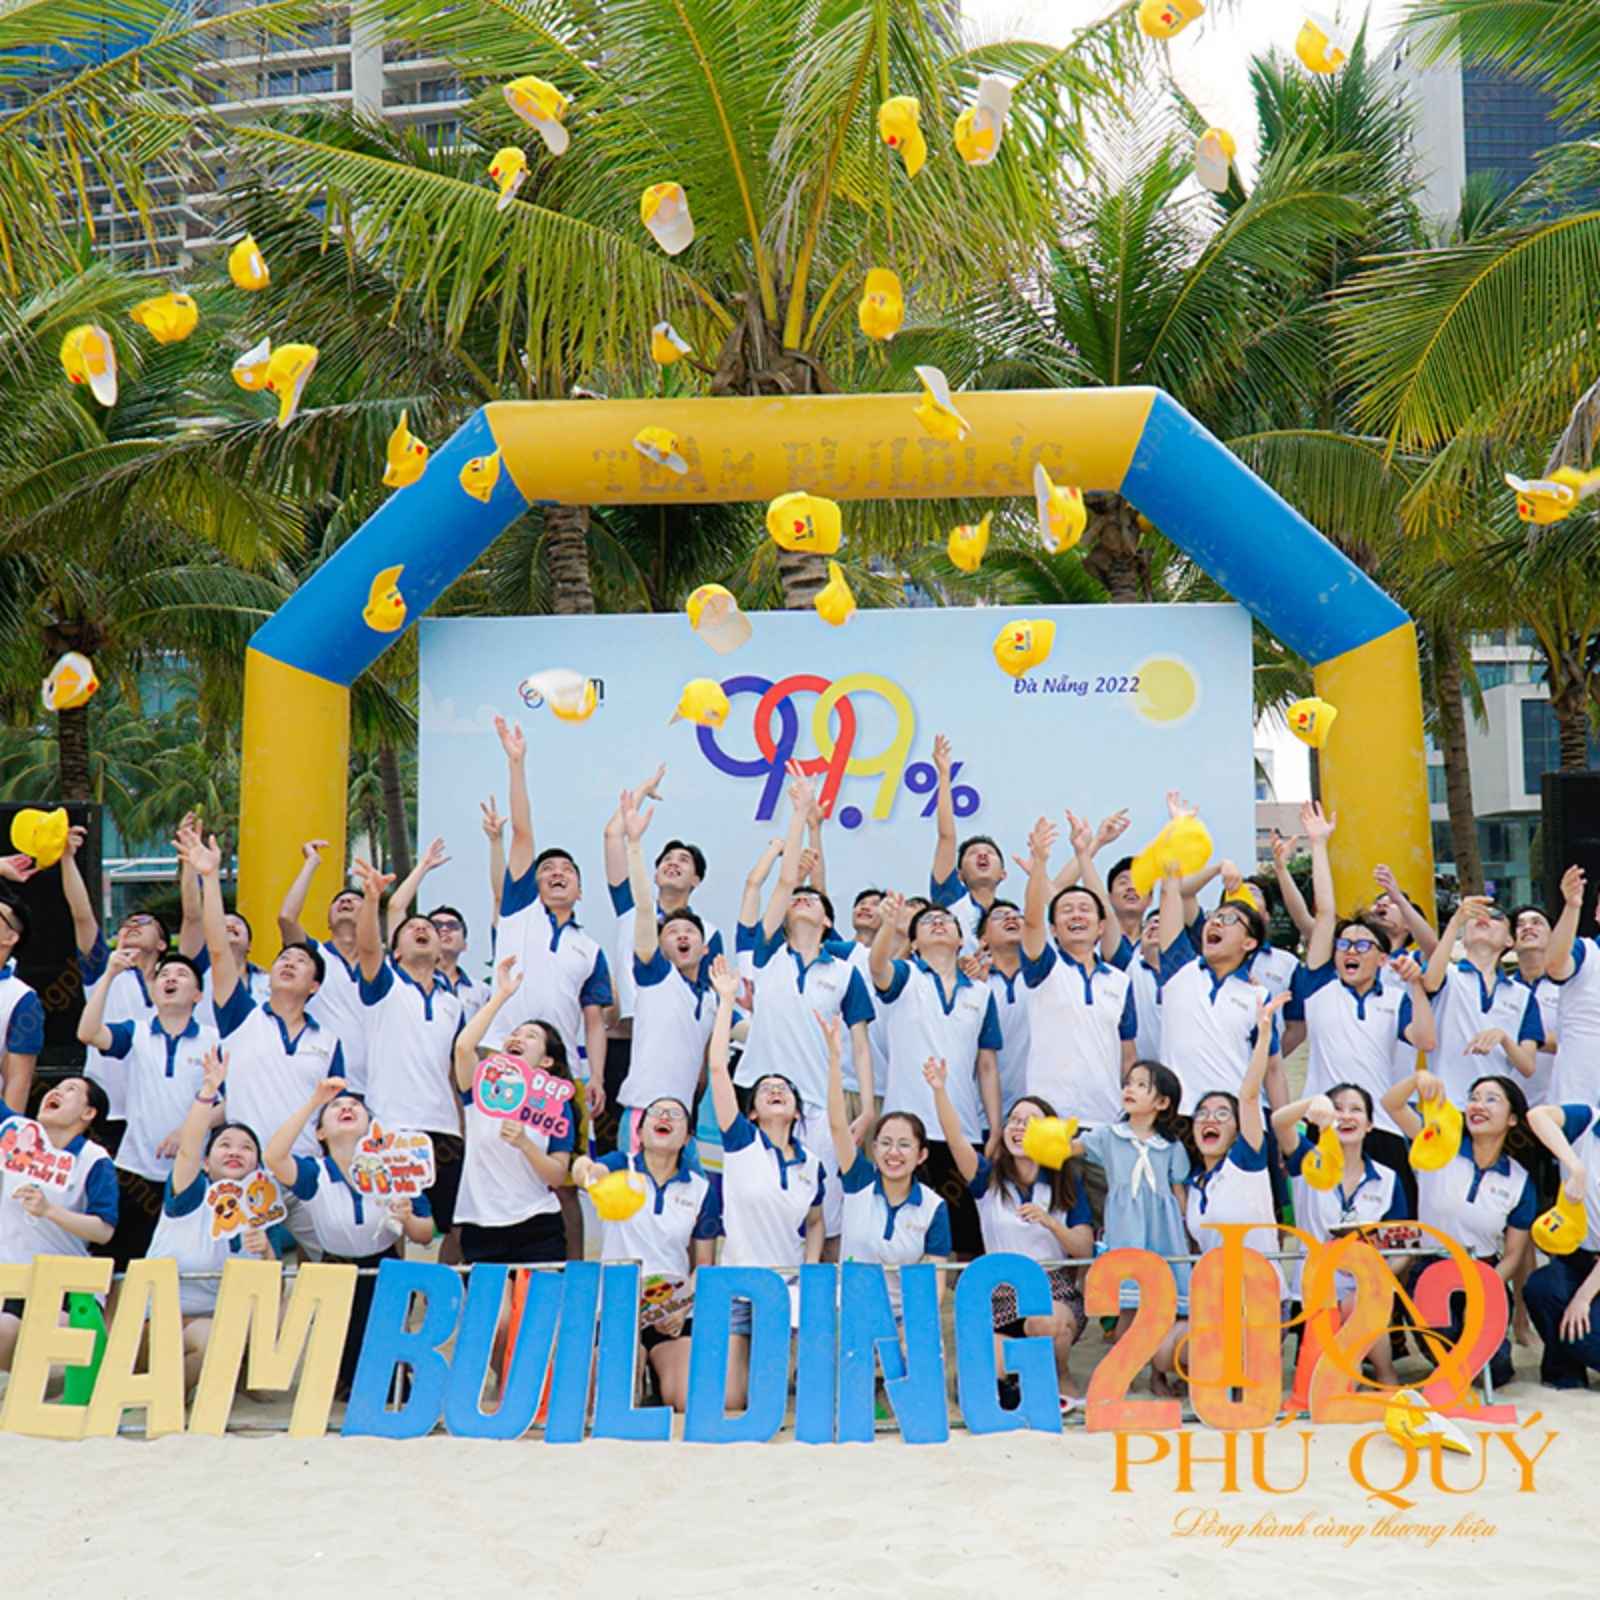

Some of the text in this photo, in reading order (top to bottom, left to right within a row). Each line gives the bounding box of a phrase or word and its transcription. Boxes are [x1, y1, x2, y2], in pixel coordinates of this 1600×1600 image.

[1014, 674, 1140, 697] Đà Nẵng 2022
[341, 1252, 1064, 1444] BUILDING
[1085, 1239, 1518, 1433] 2022
